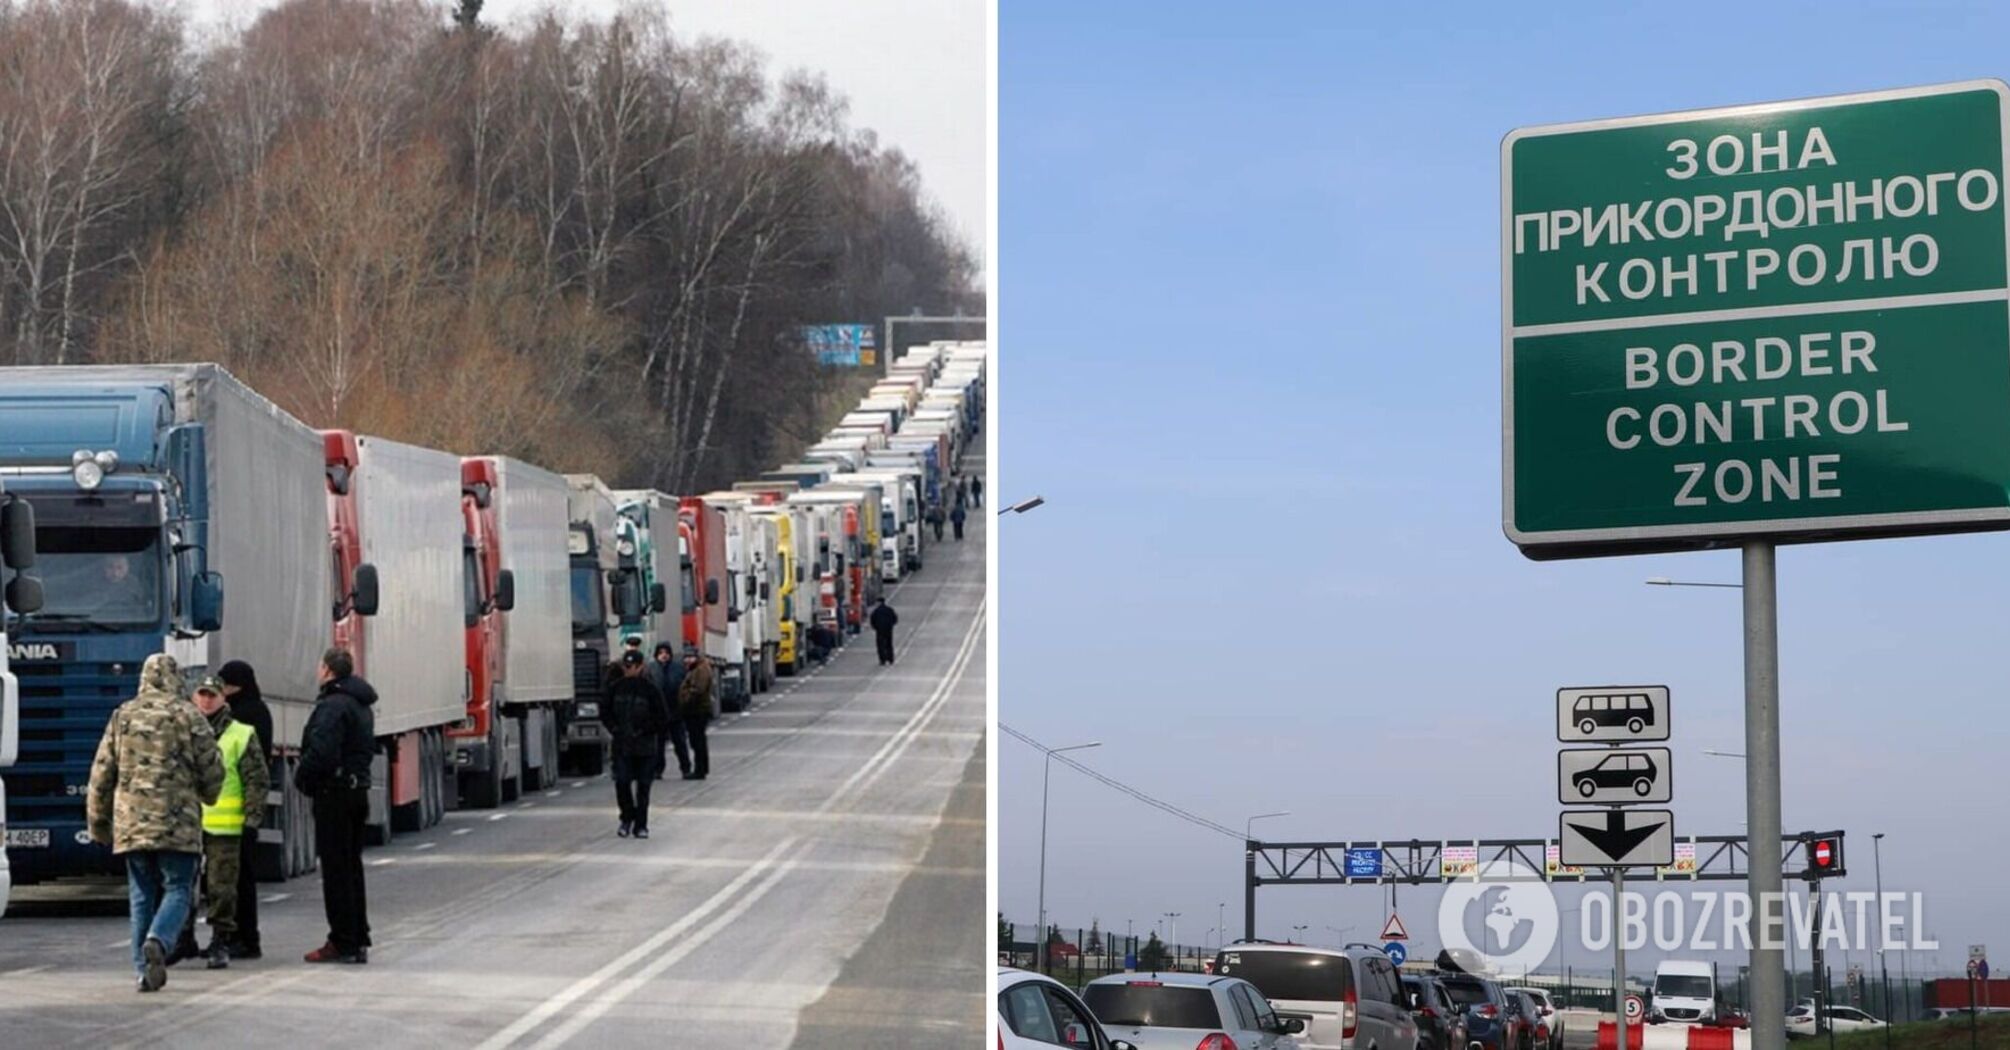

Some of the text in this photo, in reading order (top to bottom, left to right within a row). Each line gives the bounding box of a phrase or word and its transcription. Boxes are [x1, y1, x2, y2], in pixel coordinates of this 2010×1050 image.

[1665, 127, 1837, 180] ЗОНА
[1515, 169, 1999, 254] ПРИКОРДОННОГО
[1576, 234, 1940, 305] КОНТРОЛЮ
[1625, 330, 1879, 390] BORDER
[1606, 389, 1909, 449] CONTROL
[1673, 454, 1842, 506] ZONE
[7, 643, 58, 659] ANIA
[1628, 1002, 1635, 1013] 5
